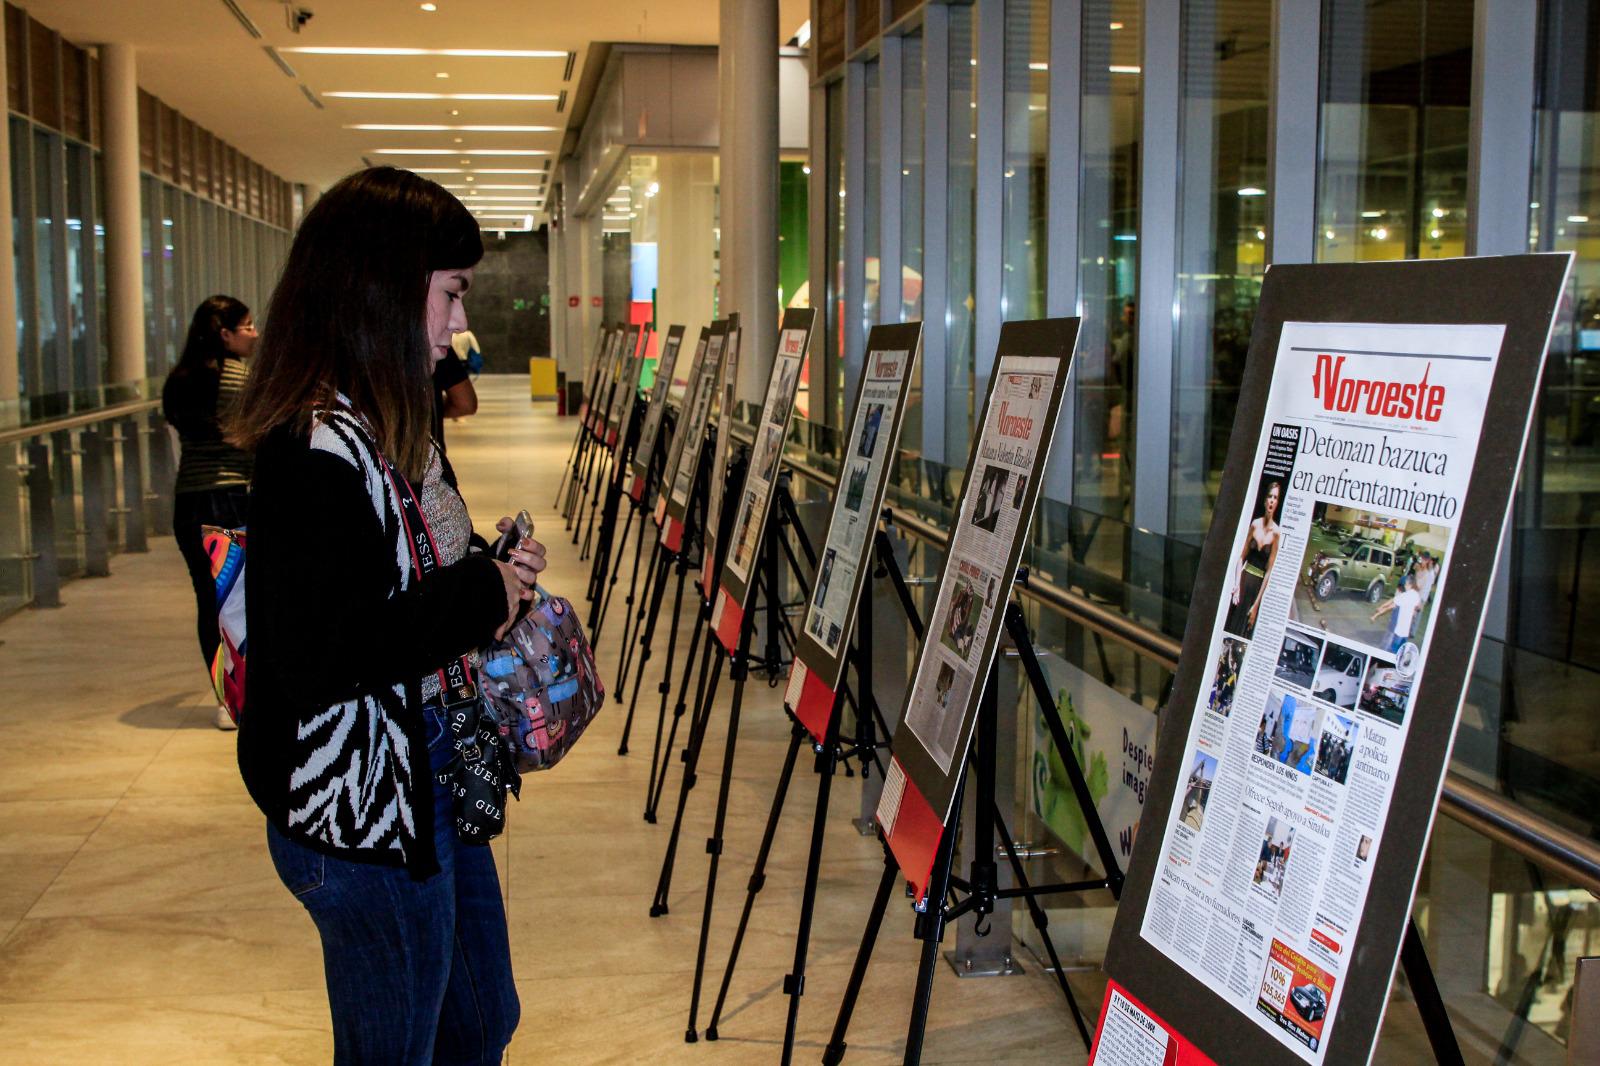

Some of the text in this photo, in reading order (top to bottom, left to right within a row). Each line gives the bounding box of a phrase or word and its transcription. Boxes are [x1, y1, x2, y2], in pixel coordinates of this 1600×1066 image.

[1312, 354, 1445, 422] Noroeste
[998, 401, 1033, 440] Noroeste
[1272, 426, 1299, 440] UN OASIS
[1300, 427, 1376, 465] Detonan
[1379, 435, 1448, 476] bazuca
[1292, 469, 1313, 493] en
[1314, 468, 1458, 520] enfrentamiento
[415, 532, 434, 573] ESS
[1251, 753, 1275, 770] RESPONDEN
[1276, 765, 1284, 776] LOS
[1263, 982, 1285, 1005] $25,365
[1271, 965, 1286, 986] 10%
